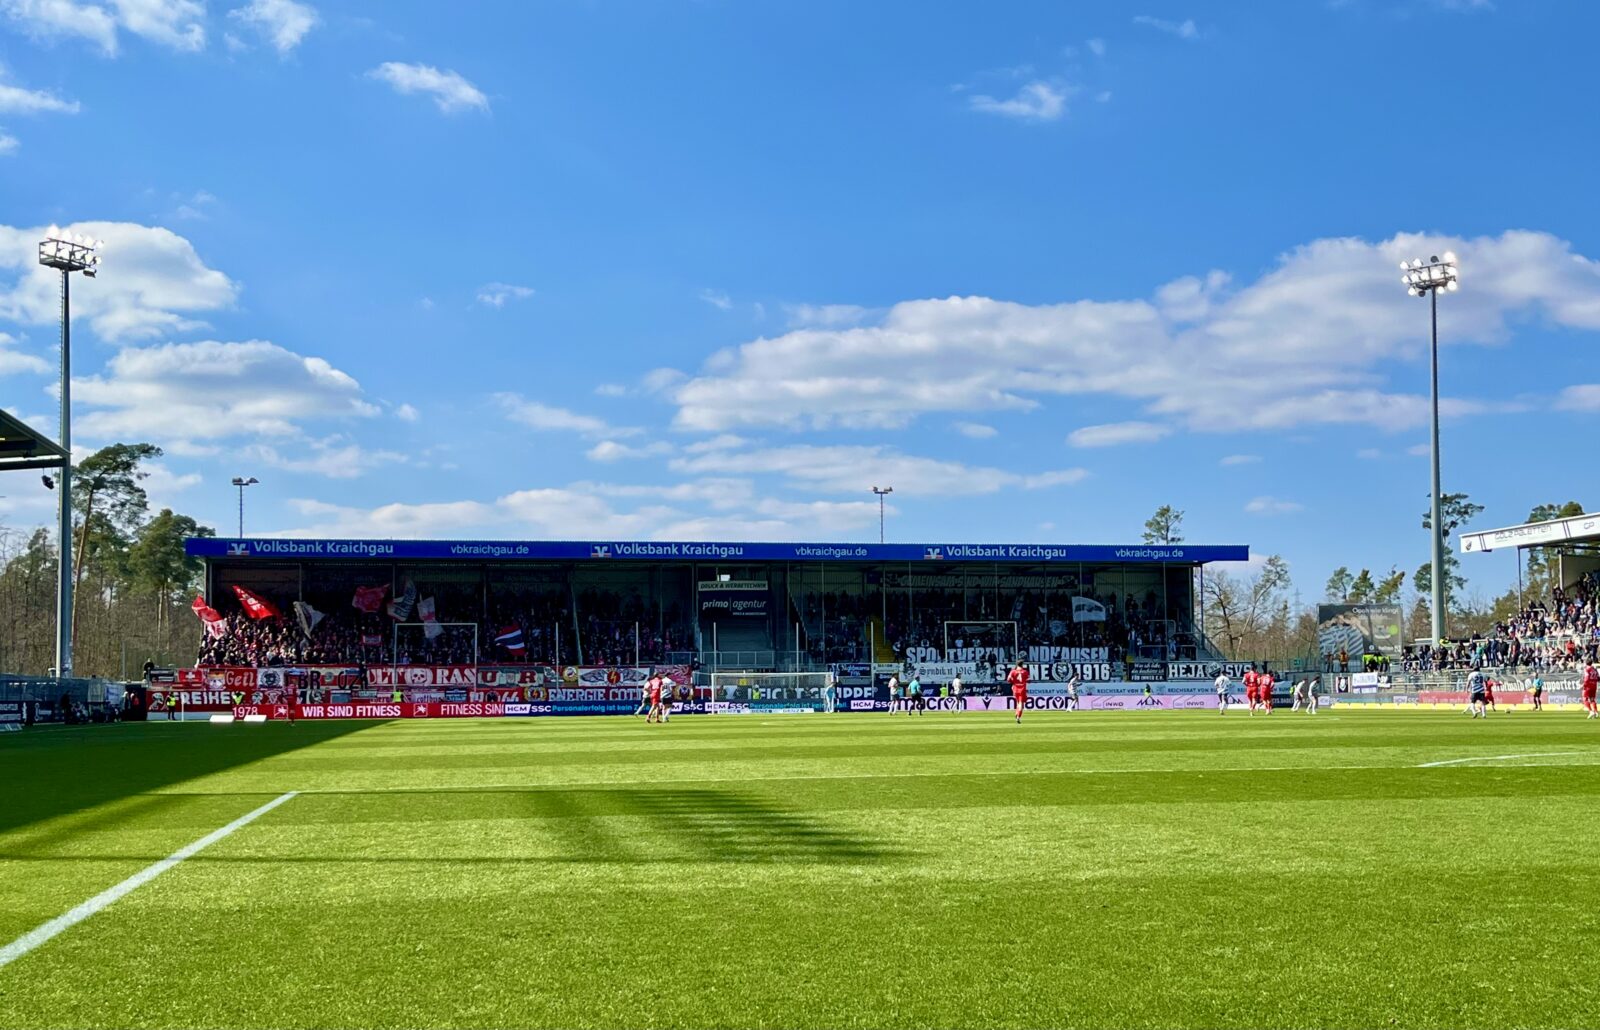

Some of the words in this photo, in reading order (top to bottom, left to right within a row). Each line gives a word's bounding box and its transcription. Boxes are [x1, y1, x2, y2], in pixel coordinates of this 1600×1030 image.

[254, 540, 323, 553] Volksbank
[327, 542, 394, 556] Kraichgau
[450, 544, 530, 556] vbkraichgau.de
[615, 543, 679, 555] Volksbank
[682, 544, 744, 558] Kraichgau
[795, 546, 868, 558] vbkraichgau.de
[946, 546, 1006, 557] Volksbank
[1008, 547, 1067, 559] Kraichgau
[1115, 548, 1184, 559] vbkraichgau.de
[702, 599, 729, 611] primo
[732, 600, 767, 611] agentur
[1075, 663, 1110, 681] 1916
[1168, 662, 1206, 680] HEJA
[225, 670, 255, 687] Geil
[548, 688, 606, 702] ENERGIE
[232, 705, 258, 718] 1978
[302, 705, 325, 718] WIR
[326, 705, 354, 717] SIND
[356, 704, 401, 717] FITNESS
[440, 703, 482, 716] FITNESS
[531, 705, 552, 713] SSC
[552, 703, 606, 713] Personalerfolg
[606, 703, 616, 711] ist
[616, 703, 632, 711] kein
[729, 702, 750, 710] SSC
